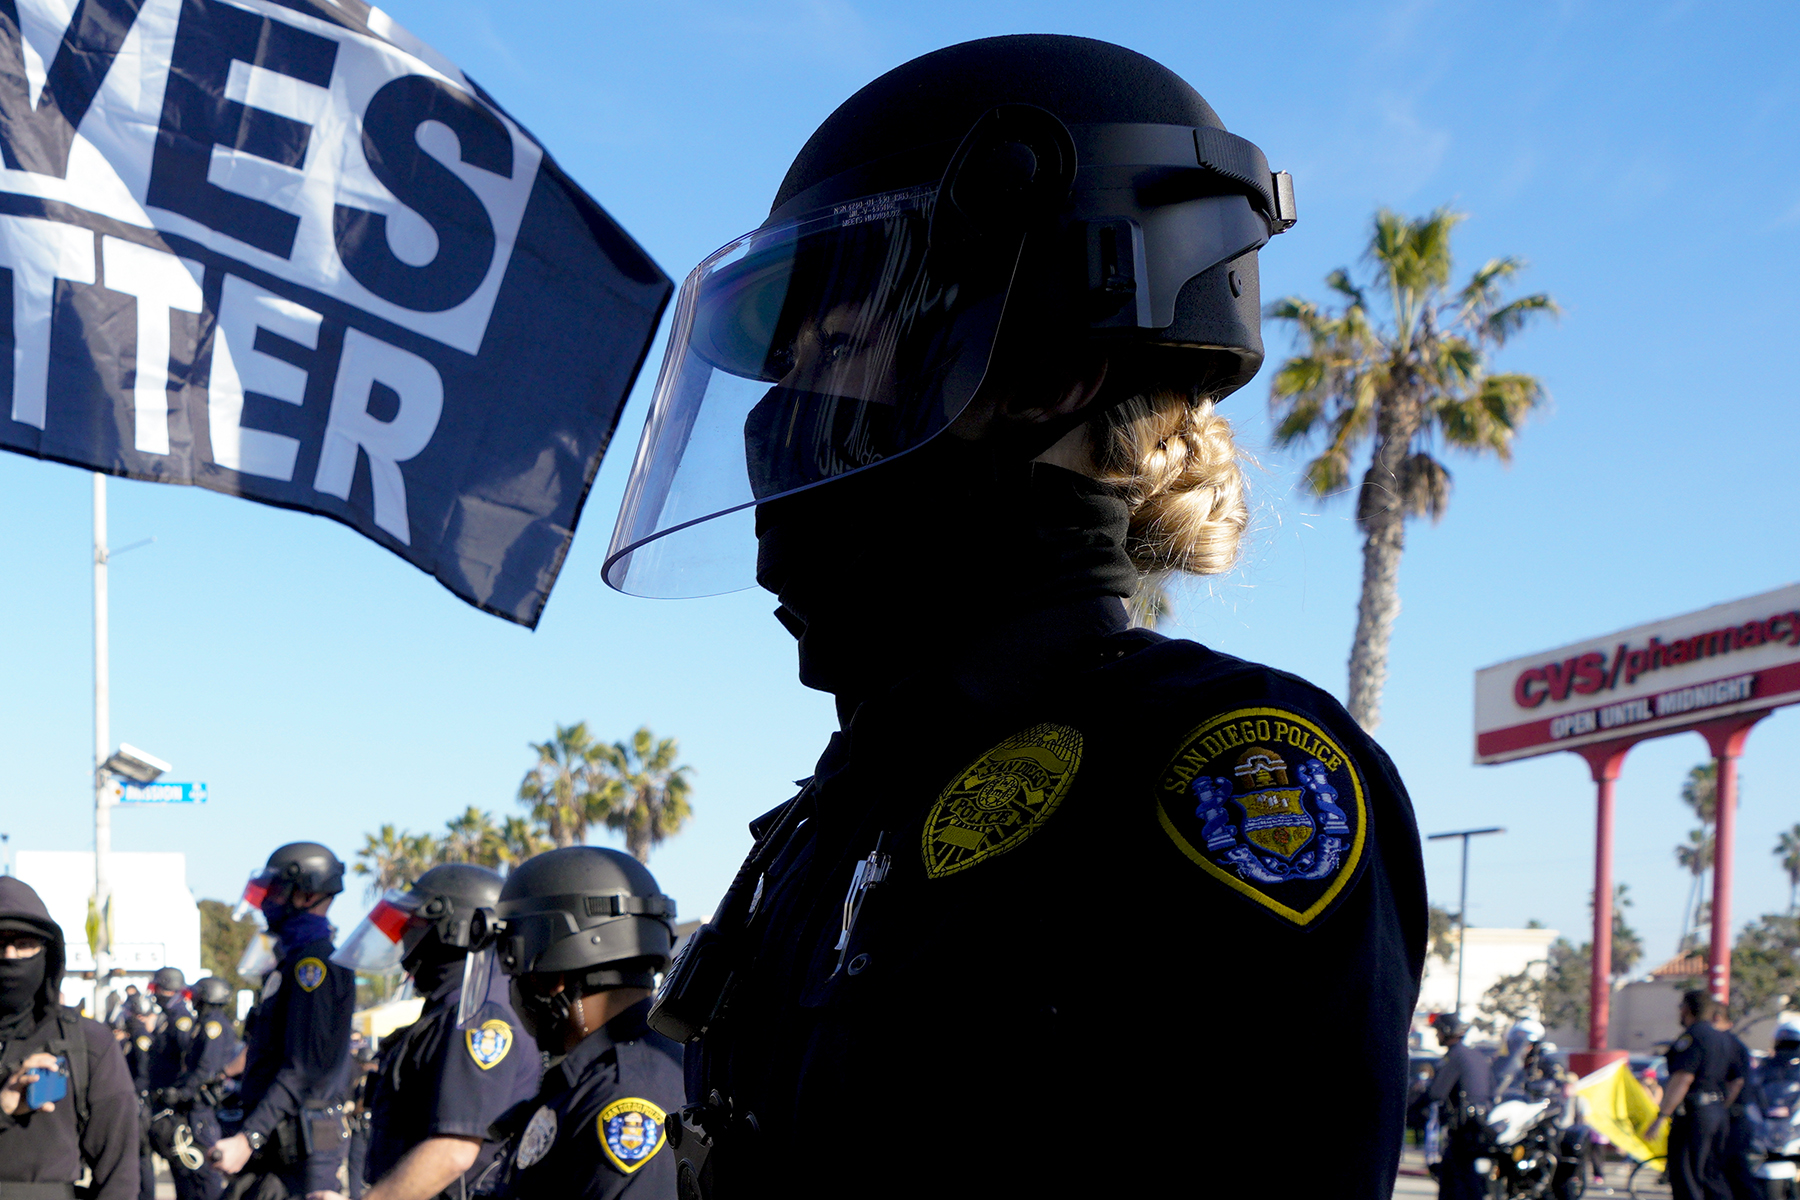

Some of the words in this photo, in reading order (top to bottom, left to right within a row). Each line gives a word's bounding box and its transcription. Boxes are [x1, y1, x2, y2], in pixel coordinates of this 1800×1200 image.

[1551, 709, 1597, 739] OPEN
[1600, 698, 1653, 729] UNTIL
[1657, 674, 1753, 716] MIDNIGHT
[1164, 748, 1210, 795] SAN
[1200, 719, 1271, 759] DIEGO
[1274, 720, 1342, 772] POLICE
